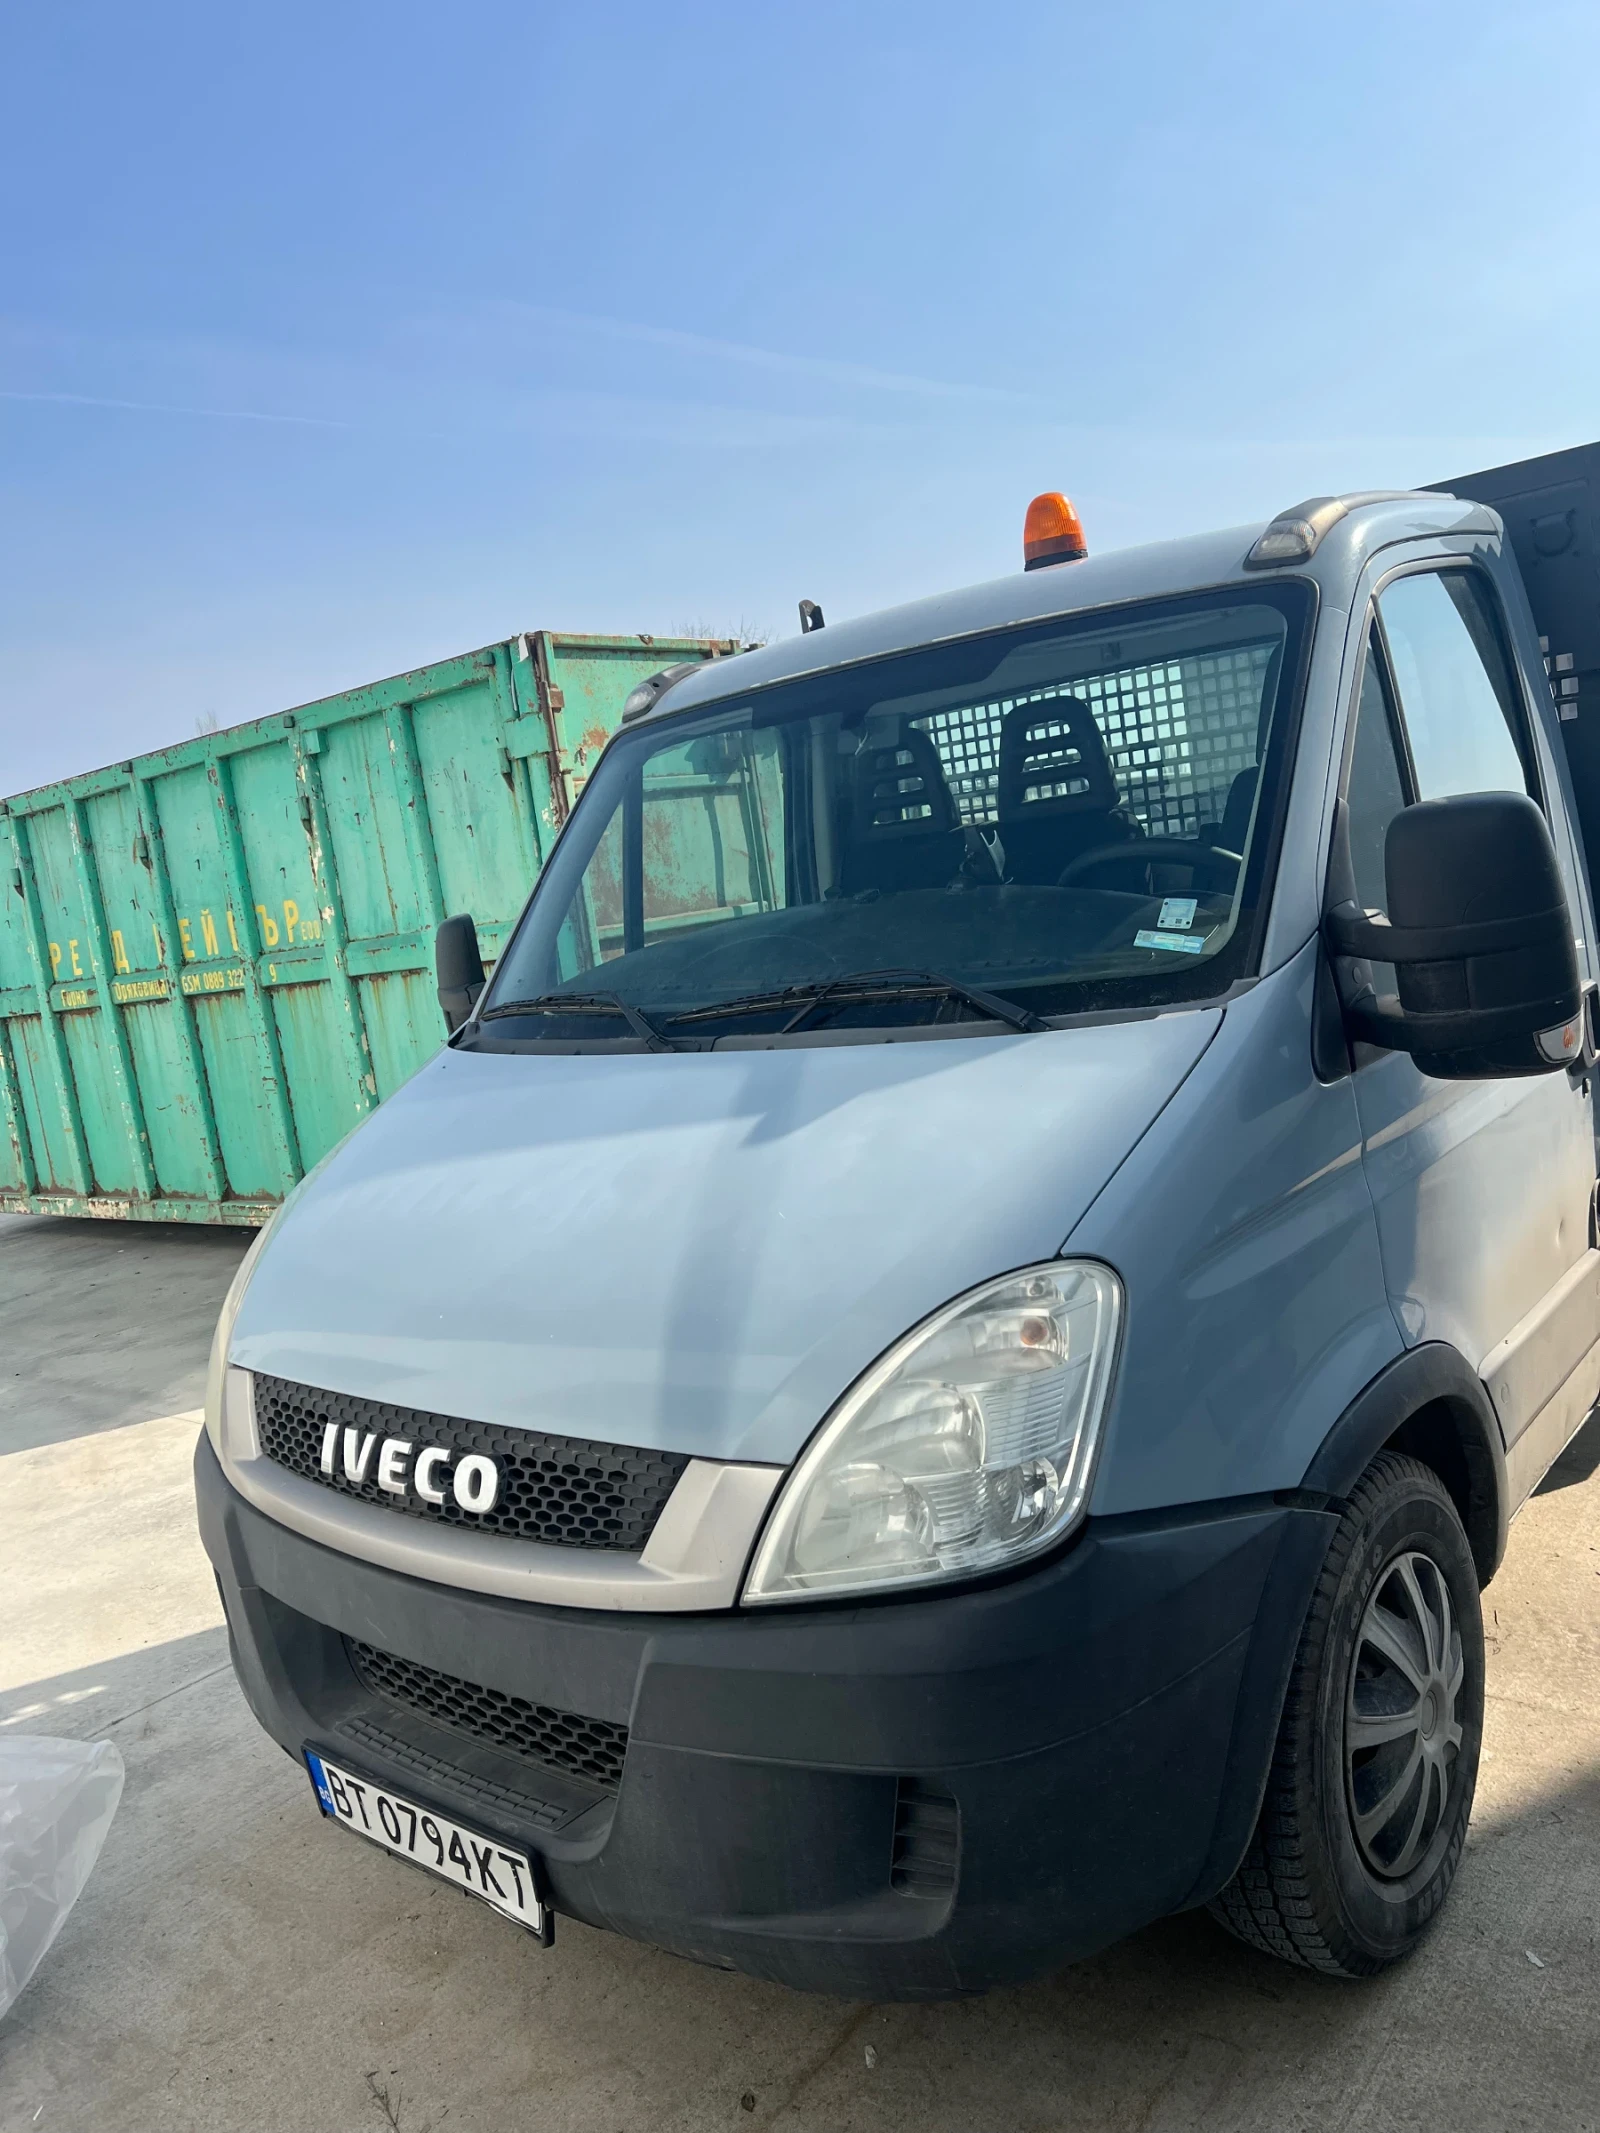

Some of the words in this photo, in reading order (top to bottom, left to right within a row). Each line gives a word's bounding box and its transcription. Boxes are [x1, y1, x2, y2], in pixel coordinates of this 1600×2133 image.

[181, 975, 201, 993] GSM
[202, 971, 225, 990] 0889
[320, 1422, 498, 1514] IVECO
